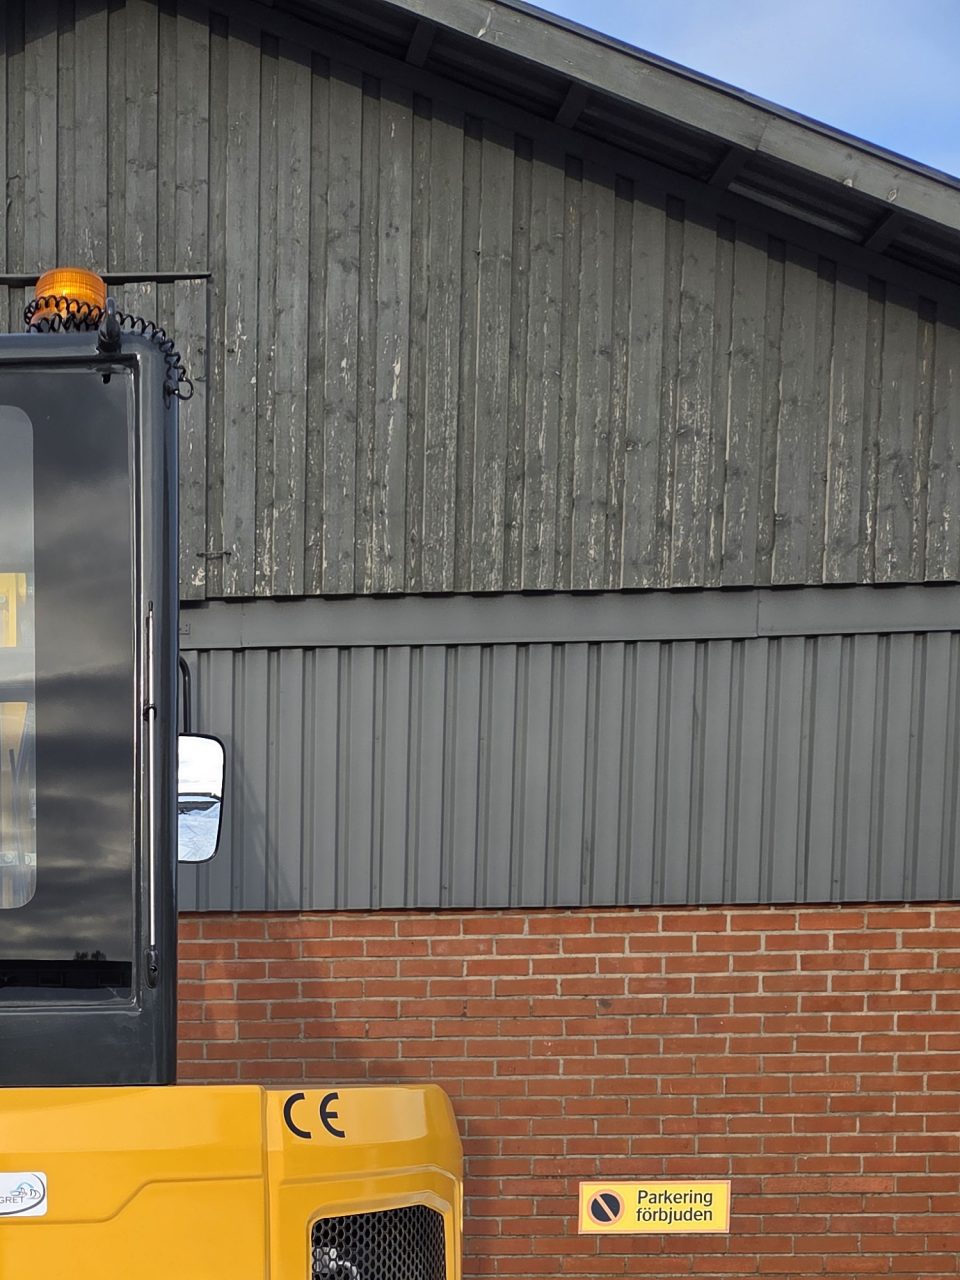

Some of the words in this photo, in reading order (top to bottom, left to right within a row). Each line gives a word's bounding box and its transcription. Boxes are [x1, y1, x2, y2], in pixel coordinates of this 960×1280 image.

[283, 1092, 345, 1139] CE
[638, 1190, 713, 1206] Parkering
[636, 1207, 713, 1224] förbjuden
